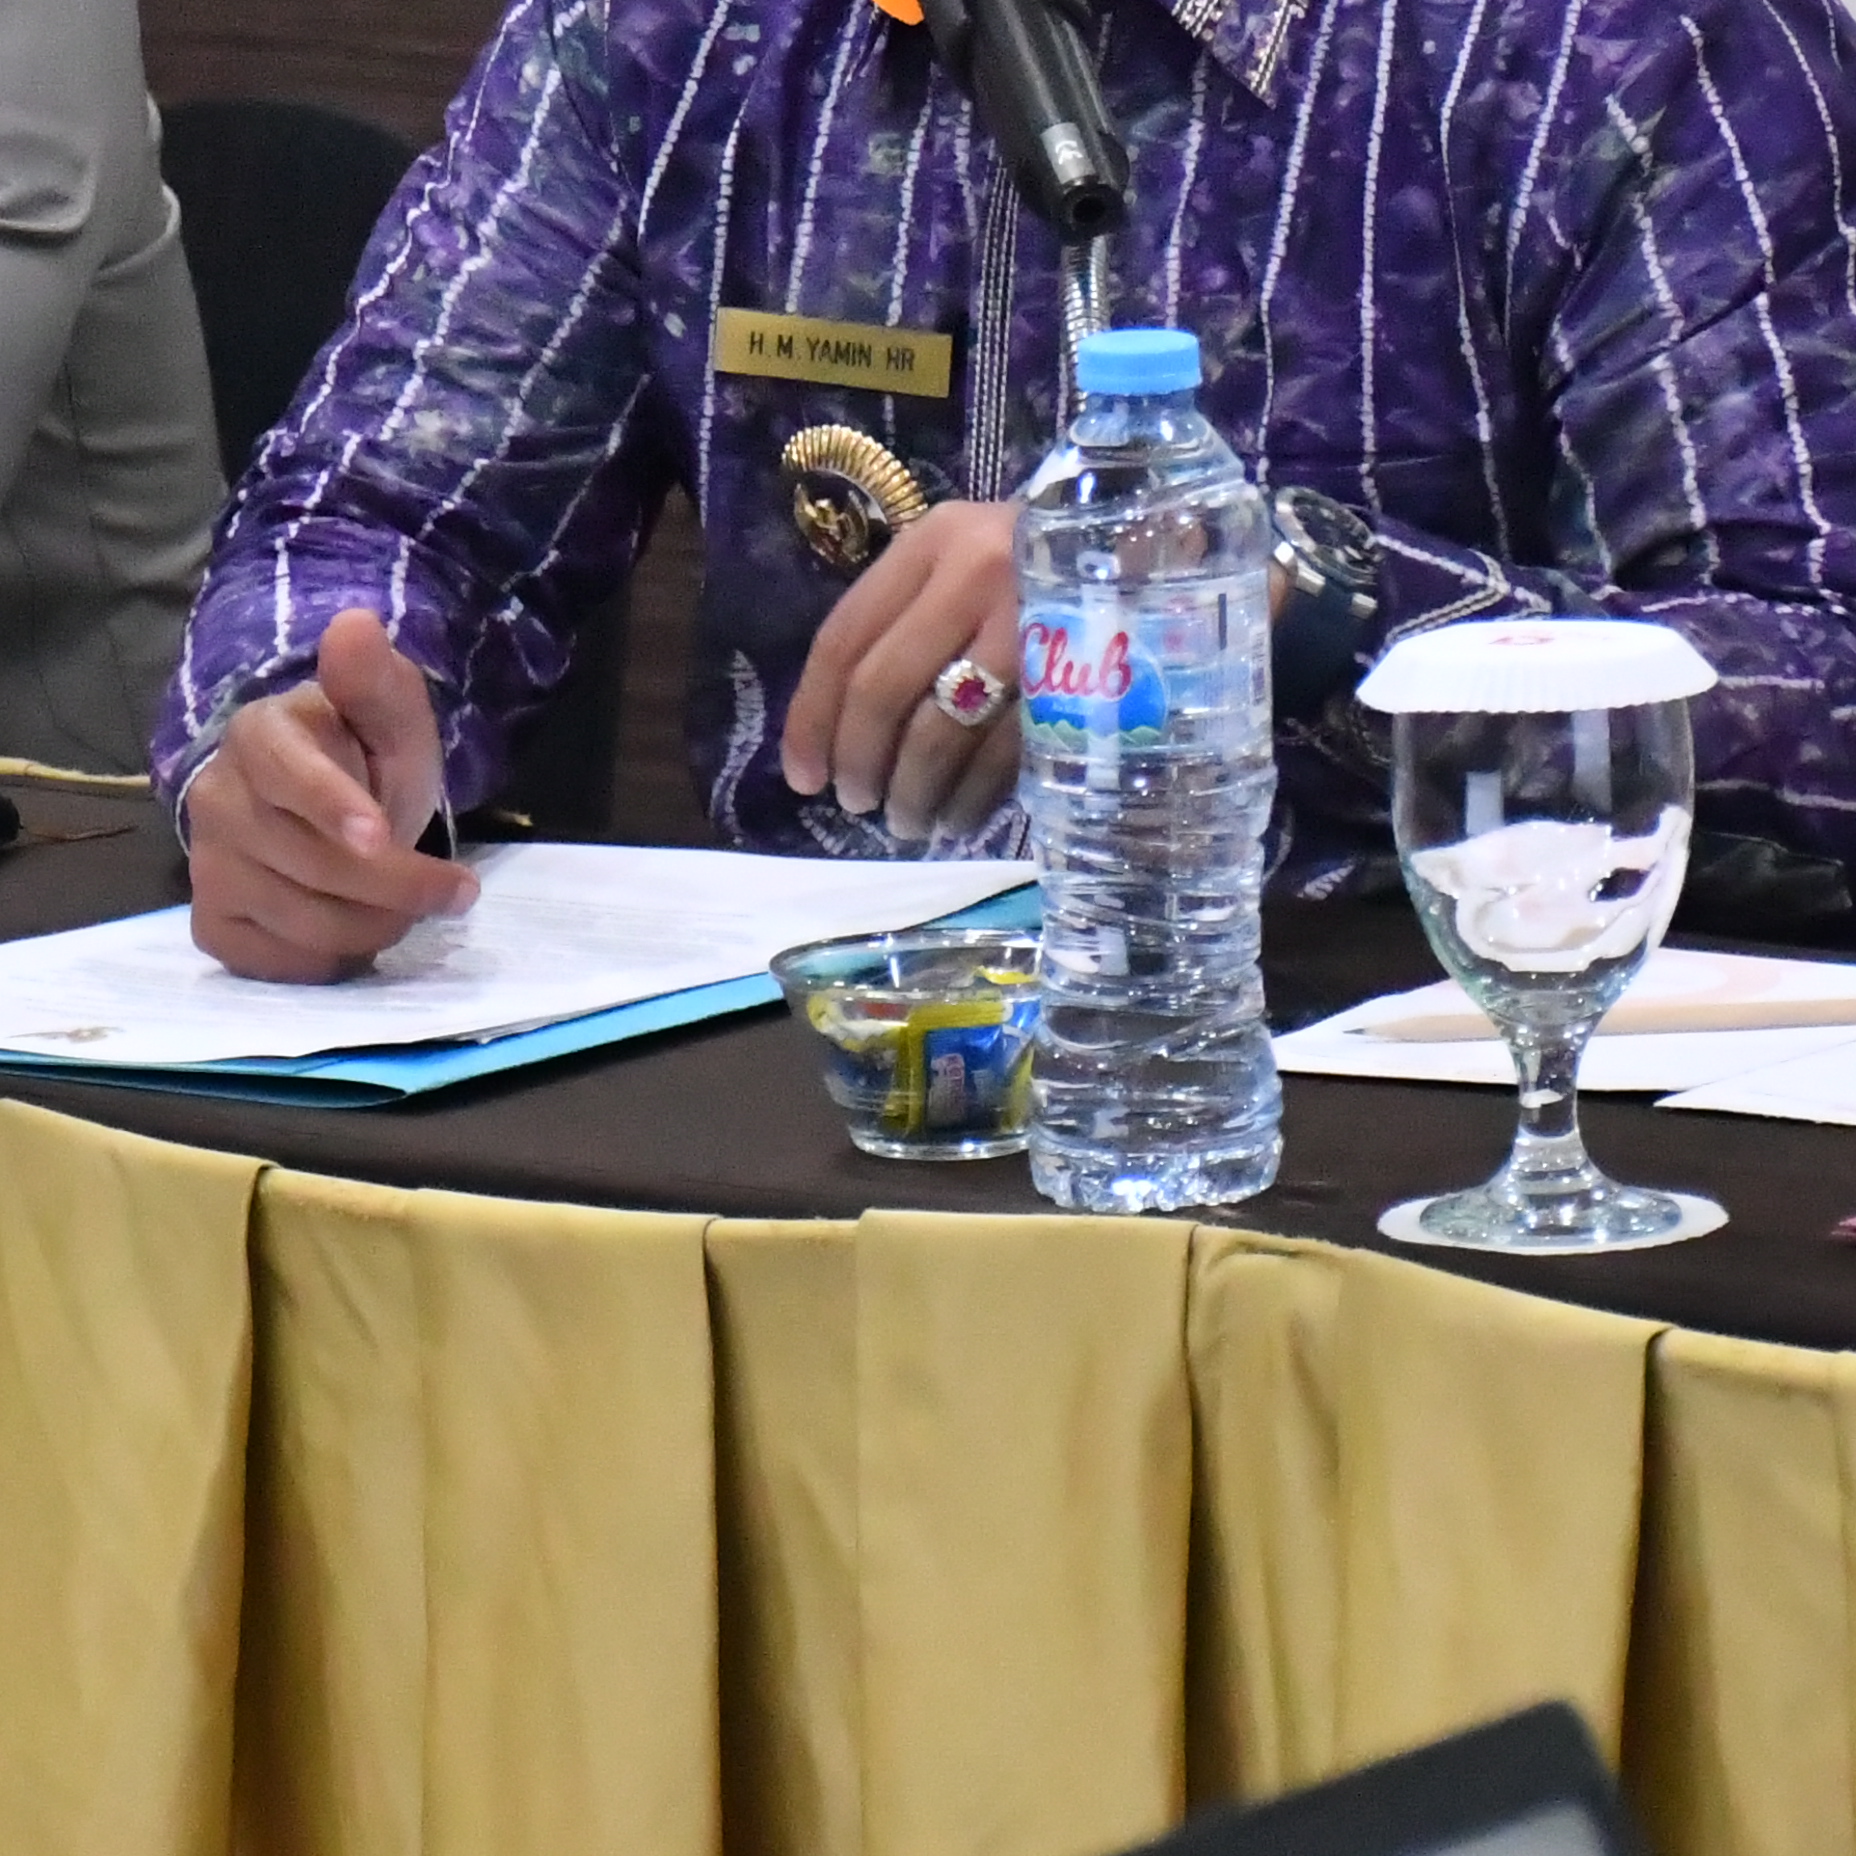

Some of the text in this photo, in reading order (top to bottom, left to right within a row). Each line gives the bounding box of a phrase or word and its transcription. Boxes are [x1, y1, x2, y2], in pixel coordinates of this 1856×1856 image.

[806, 336, 873, 369] YAMIN
[886, 346, 915, 372] HR
[1021, 621, 1133, 702] Club
